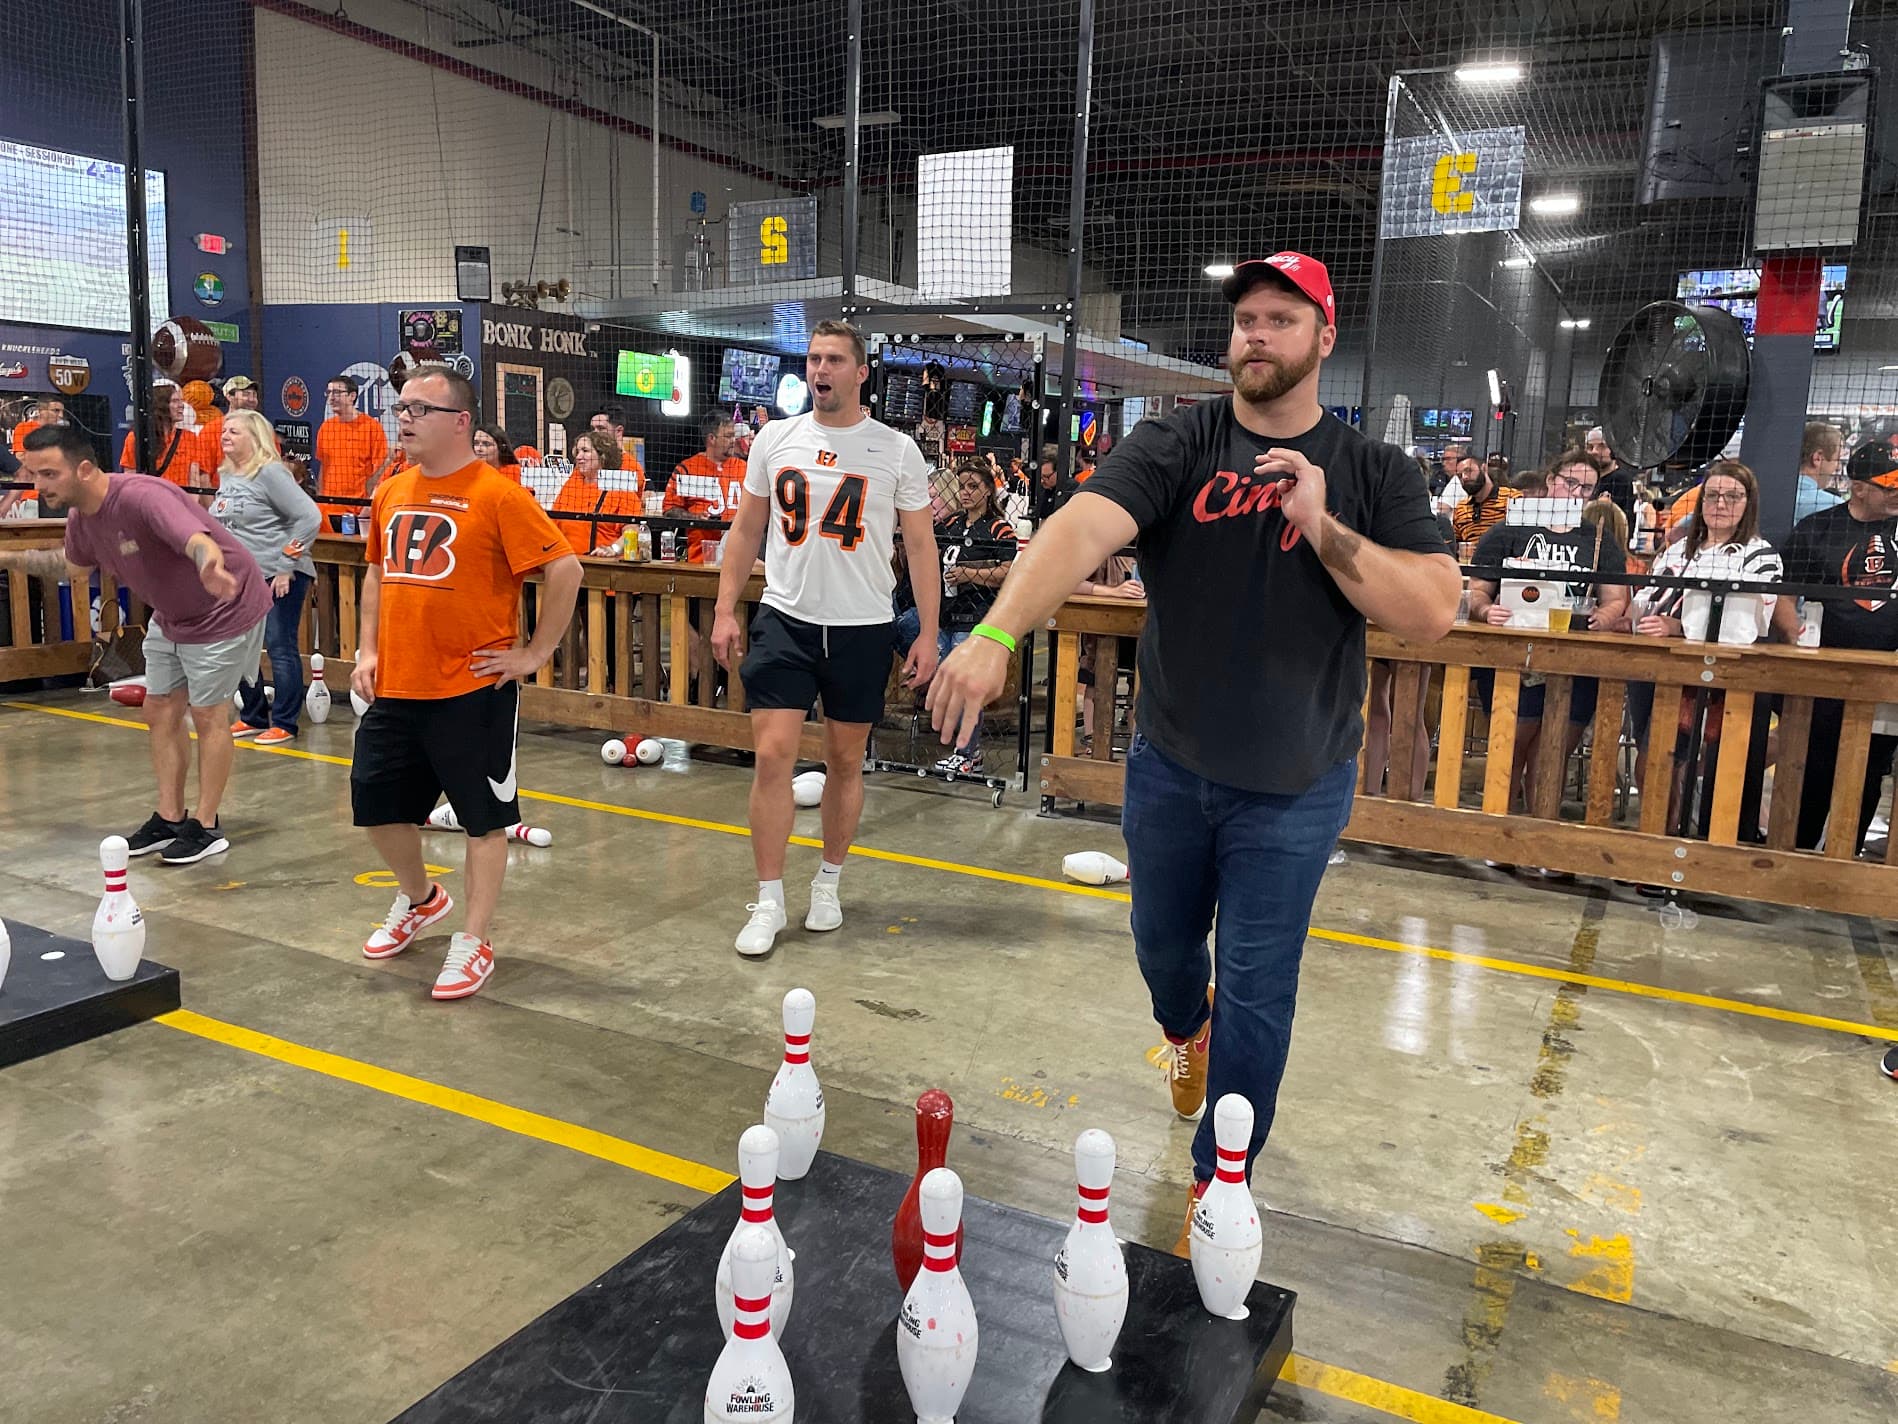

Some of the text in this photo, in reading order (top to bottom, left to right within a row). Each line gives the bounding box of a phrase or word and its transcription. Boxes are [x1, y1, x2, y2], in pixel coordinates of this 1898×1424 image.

[482, 319, 533, 350] BONK
[540, 328, 587, 357] HONK
[774, 466, 869, 552] 94
[1535, 542, 1579, 564] WHY
[726, 1402, 775, 1414] WAREHOUSE
[730, 1392, 771, 1404] FOWLING
